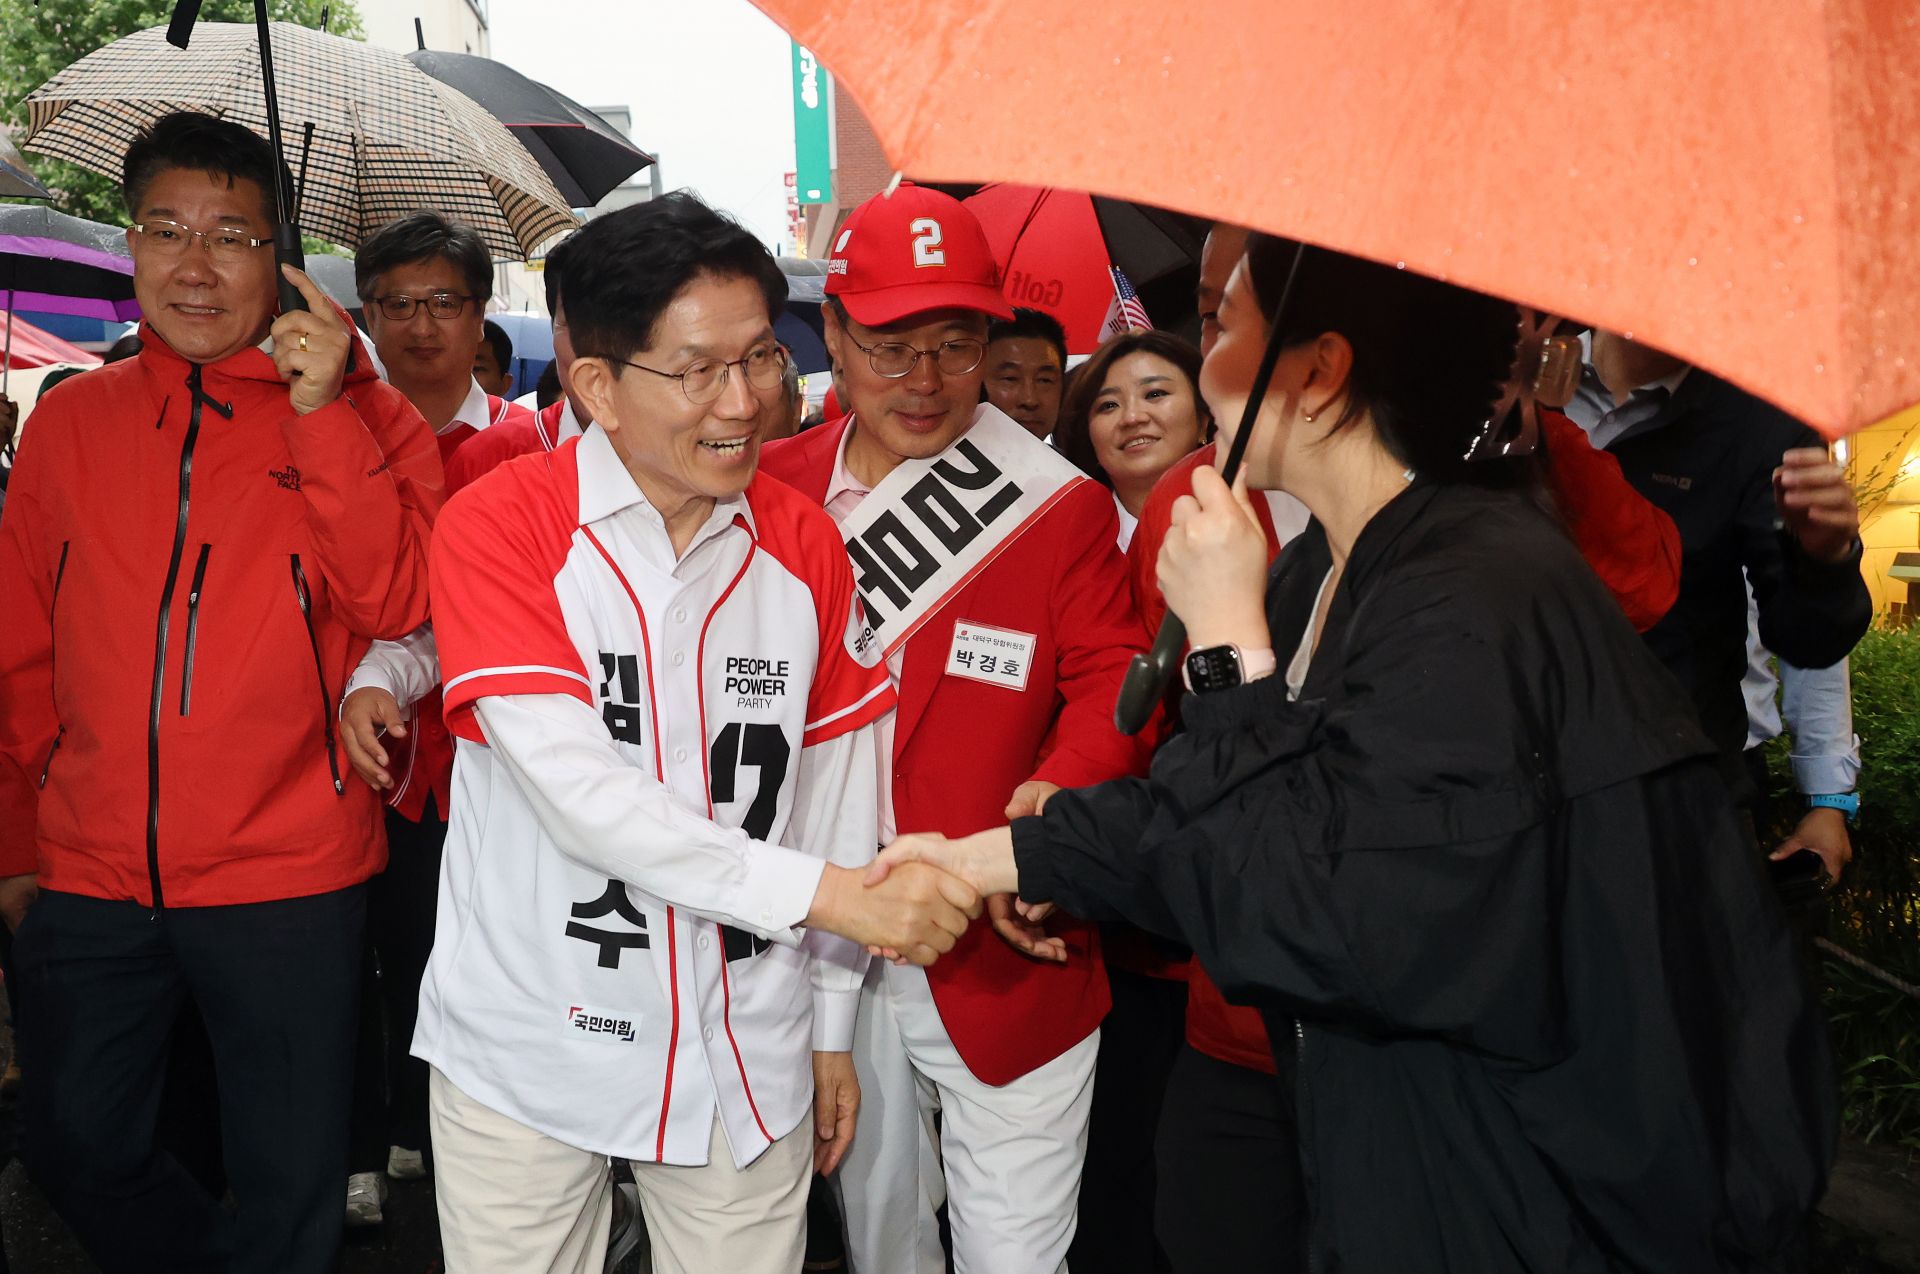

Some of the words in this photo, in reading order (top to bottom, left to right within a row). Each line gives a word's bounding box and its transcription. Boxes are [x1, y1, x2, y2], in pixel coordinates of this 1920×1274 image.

[909, 217, 946, 268] 2
[277, 480, 302, 492] FACE
[726, 656, 789, 677] PEOPLE
[725, 676, 786, 696] POWER
[737, 697, 772, 709] PARTY
[574, 1013, 632, 1037] 국민의힘
